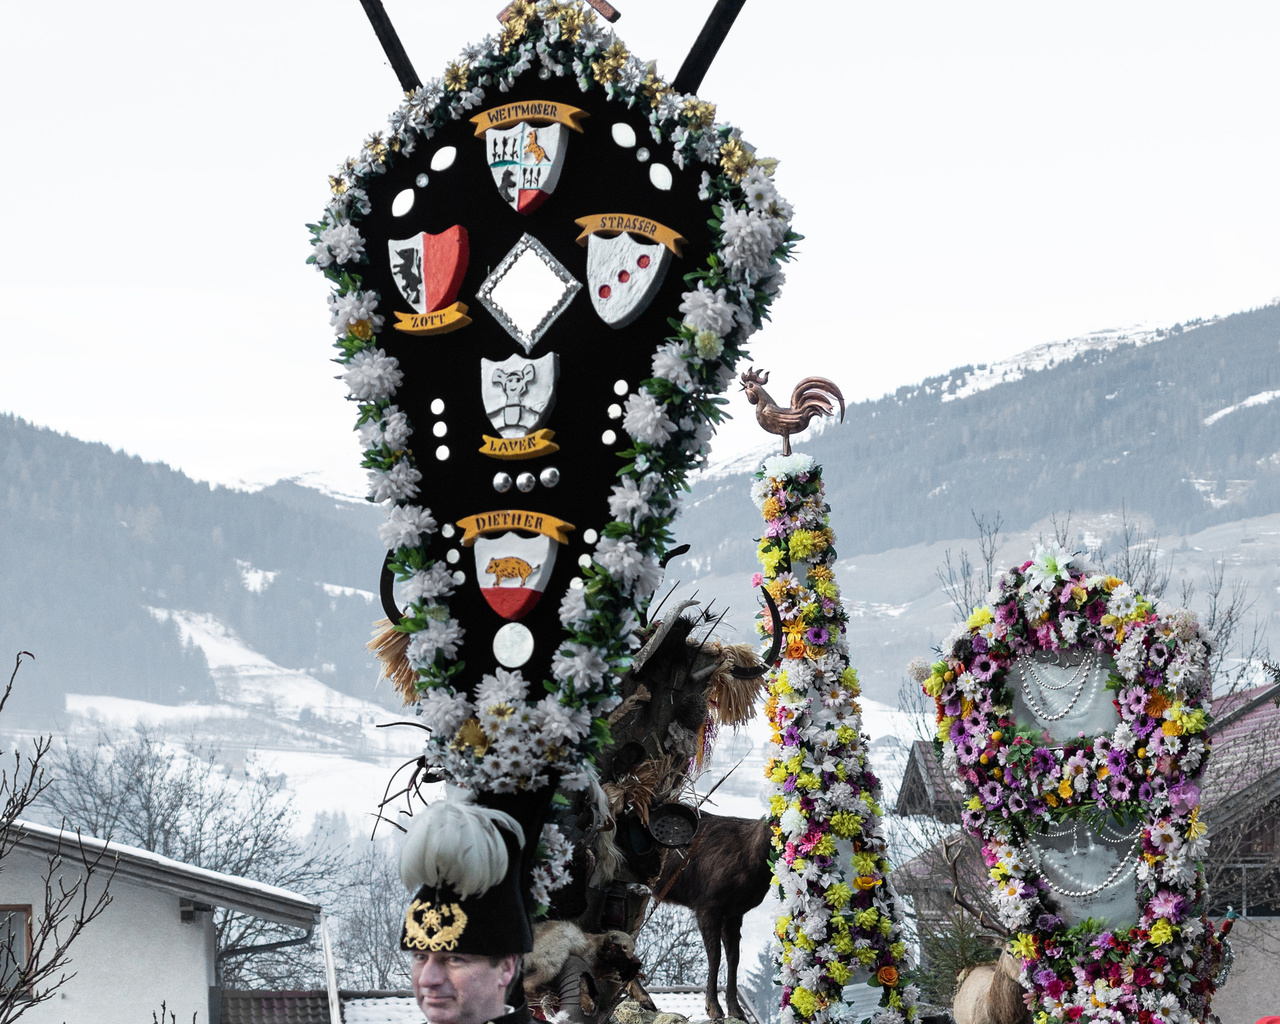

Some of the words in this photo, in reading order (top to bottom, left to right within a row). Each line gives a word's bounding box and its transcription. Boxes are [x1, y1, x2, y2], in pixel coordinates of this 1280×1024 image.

[487, 103, 558, 124] WEITMOSER
[600, 216, 657, 236] STRASSER
[411, 313, 446, 328] ZOTT
[475, 513, 543, 530] DIETHER
